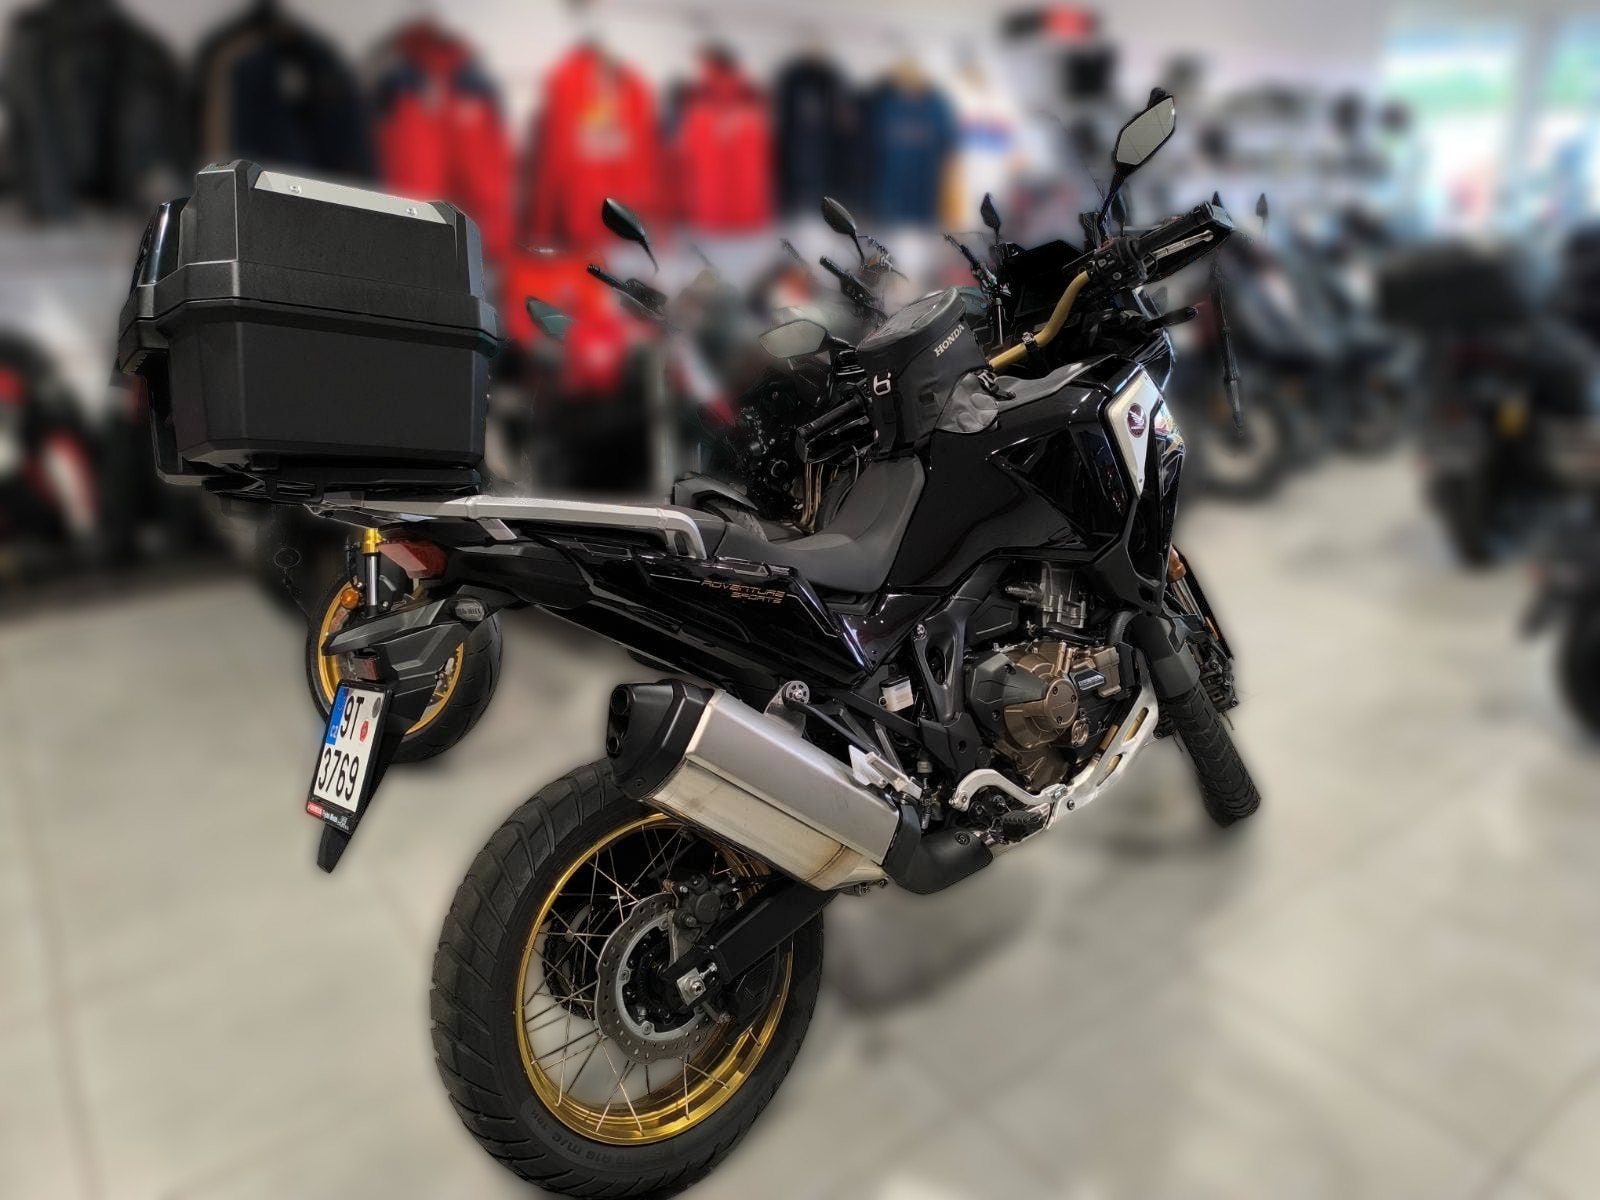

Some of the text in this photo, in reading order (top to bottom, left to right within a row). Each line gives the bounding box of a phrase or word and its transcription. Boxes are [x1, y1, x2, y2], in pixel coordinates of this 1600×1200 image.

[933, 324, 965, 357] HONDA
[339, 695, 365, 740] 9T
[317, 749, 360, 801] 3769
